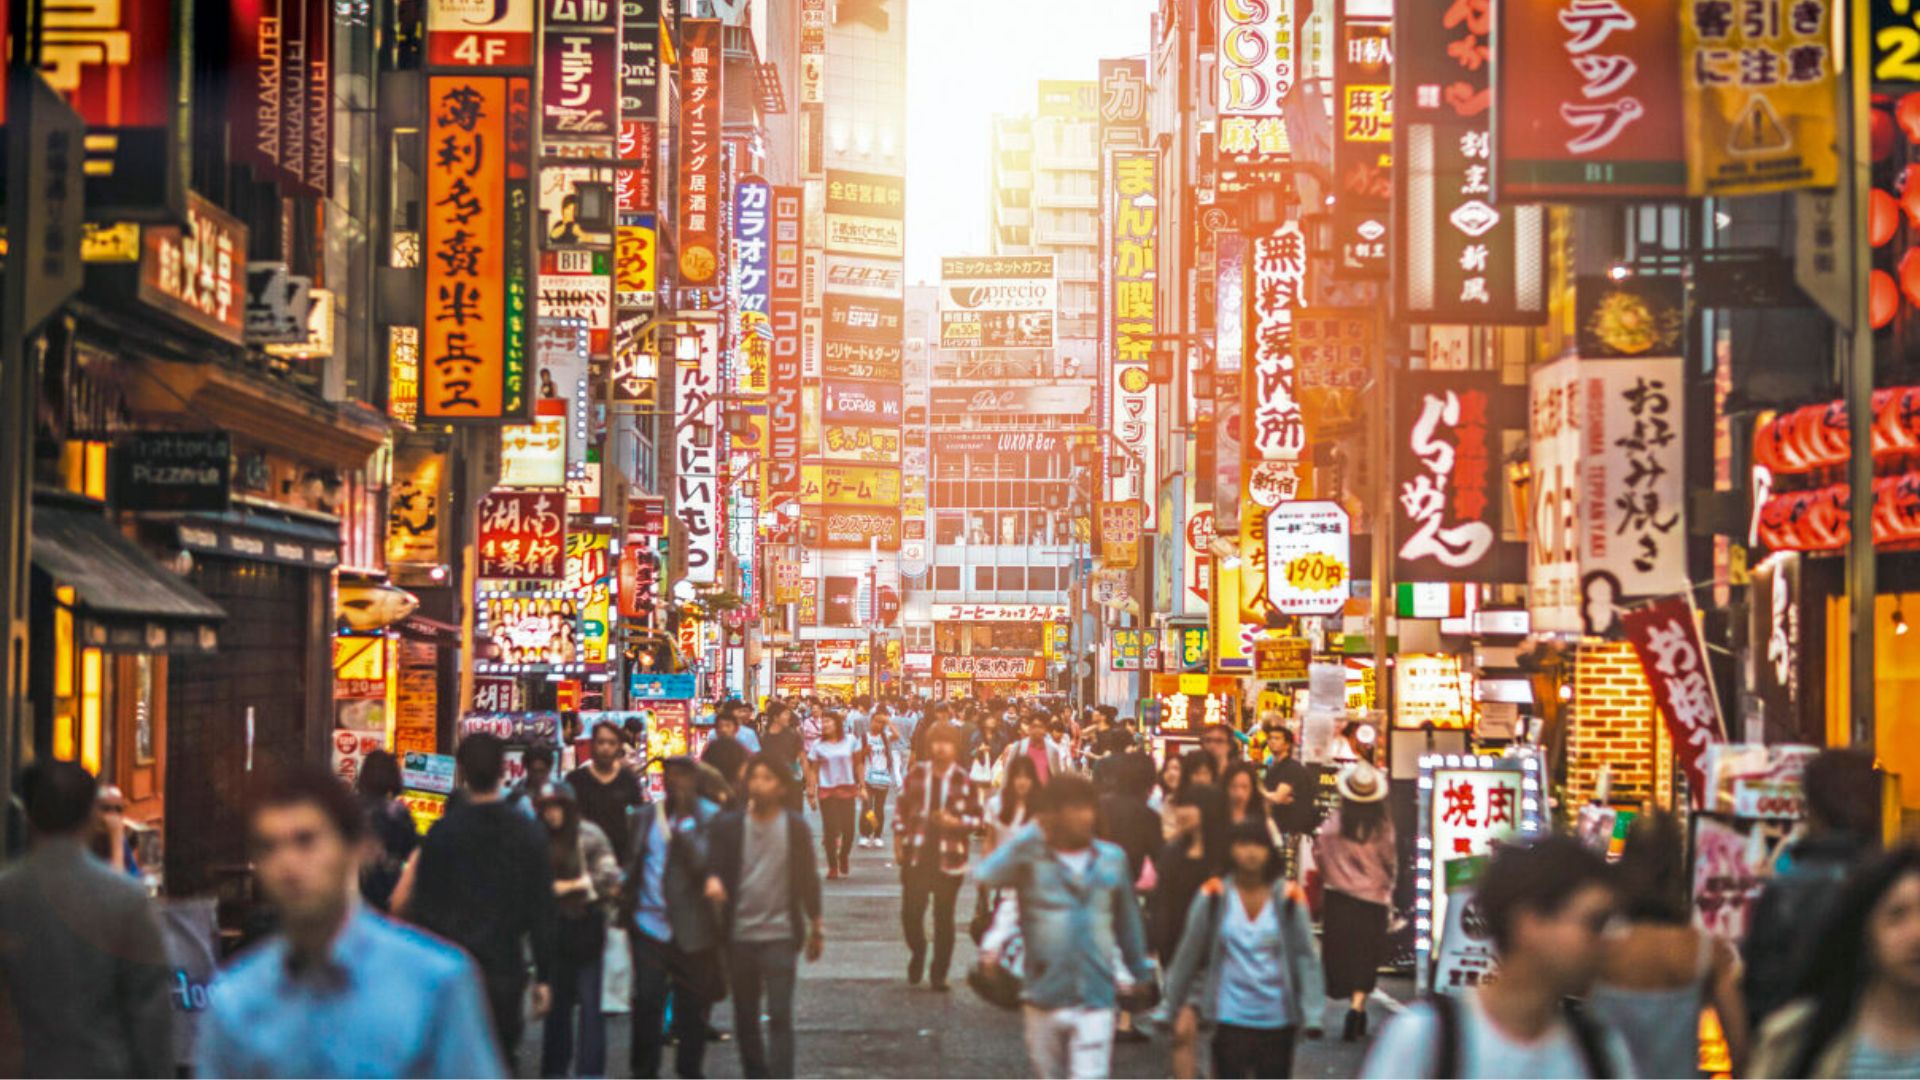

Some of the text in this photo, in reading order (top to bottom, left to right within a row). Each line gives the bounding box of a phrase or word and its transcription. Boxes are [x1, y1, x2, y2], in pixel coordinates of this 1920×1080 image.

[452, 34, 507, 66] 4F
[1696, 46, 1823, 86] に注意
[257, 15, 281, 160] ANRAKUTEI
[560, 36, 594, 107] エデン
[689, 47, 709, 231] 個室ダイニング居酒屋
[1220, 118, 1292, 154] 麻雀
[739, 184, 768, 291] カラオケ
[1116, 157, 1156, 361] まんが喫茶
[1255, 233, 1304, 449] 無料案内所
[998, 433, 1033, 450] LUXOR
[1036, 433, 1055, 450] Bar
[826, 478, 873, 499] ゲーム
[1253, 472, 1294, 493] 新宿
[1615, 377, 1680, 573] お好み焼き
[482, 495, 560, 536] 湖南
[1287, 558, 1341, 584] 190円
[949, 605, 995, 619] コーヒー
[1029, 605, 1053, 619] クール
[819, 656, 852, 669] ゲーム
